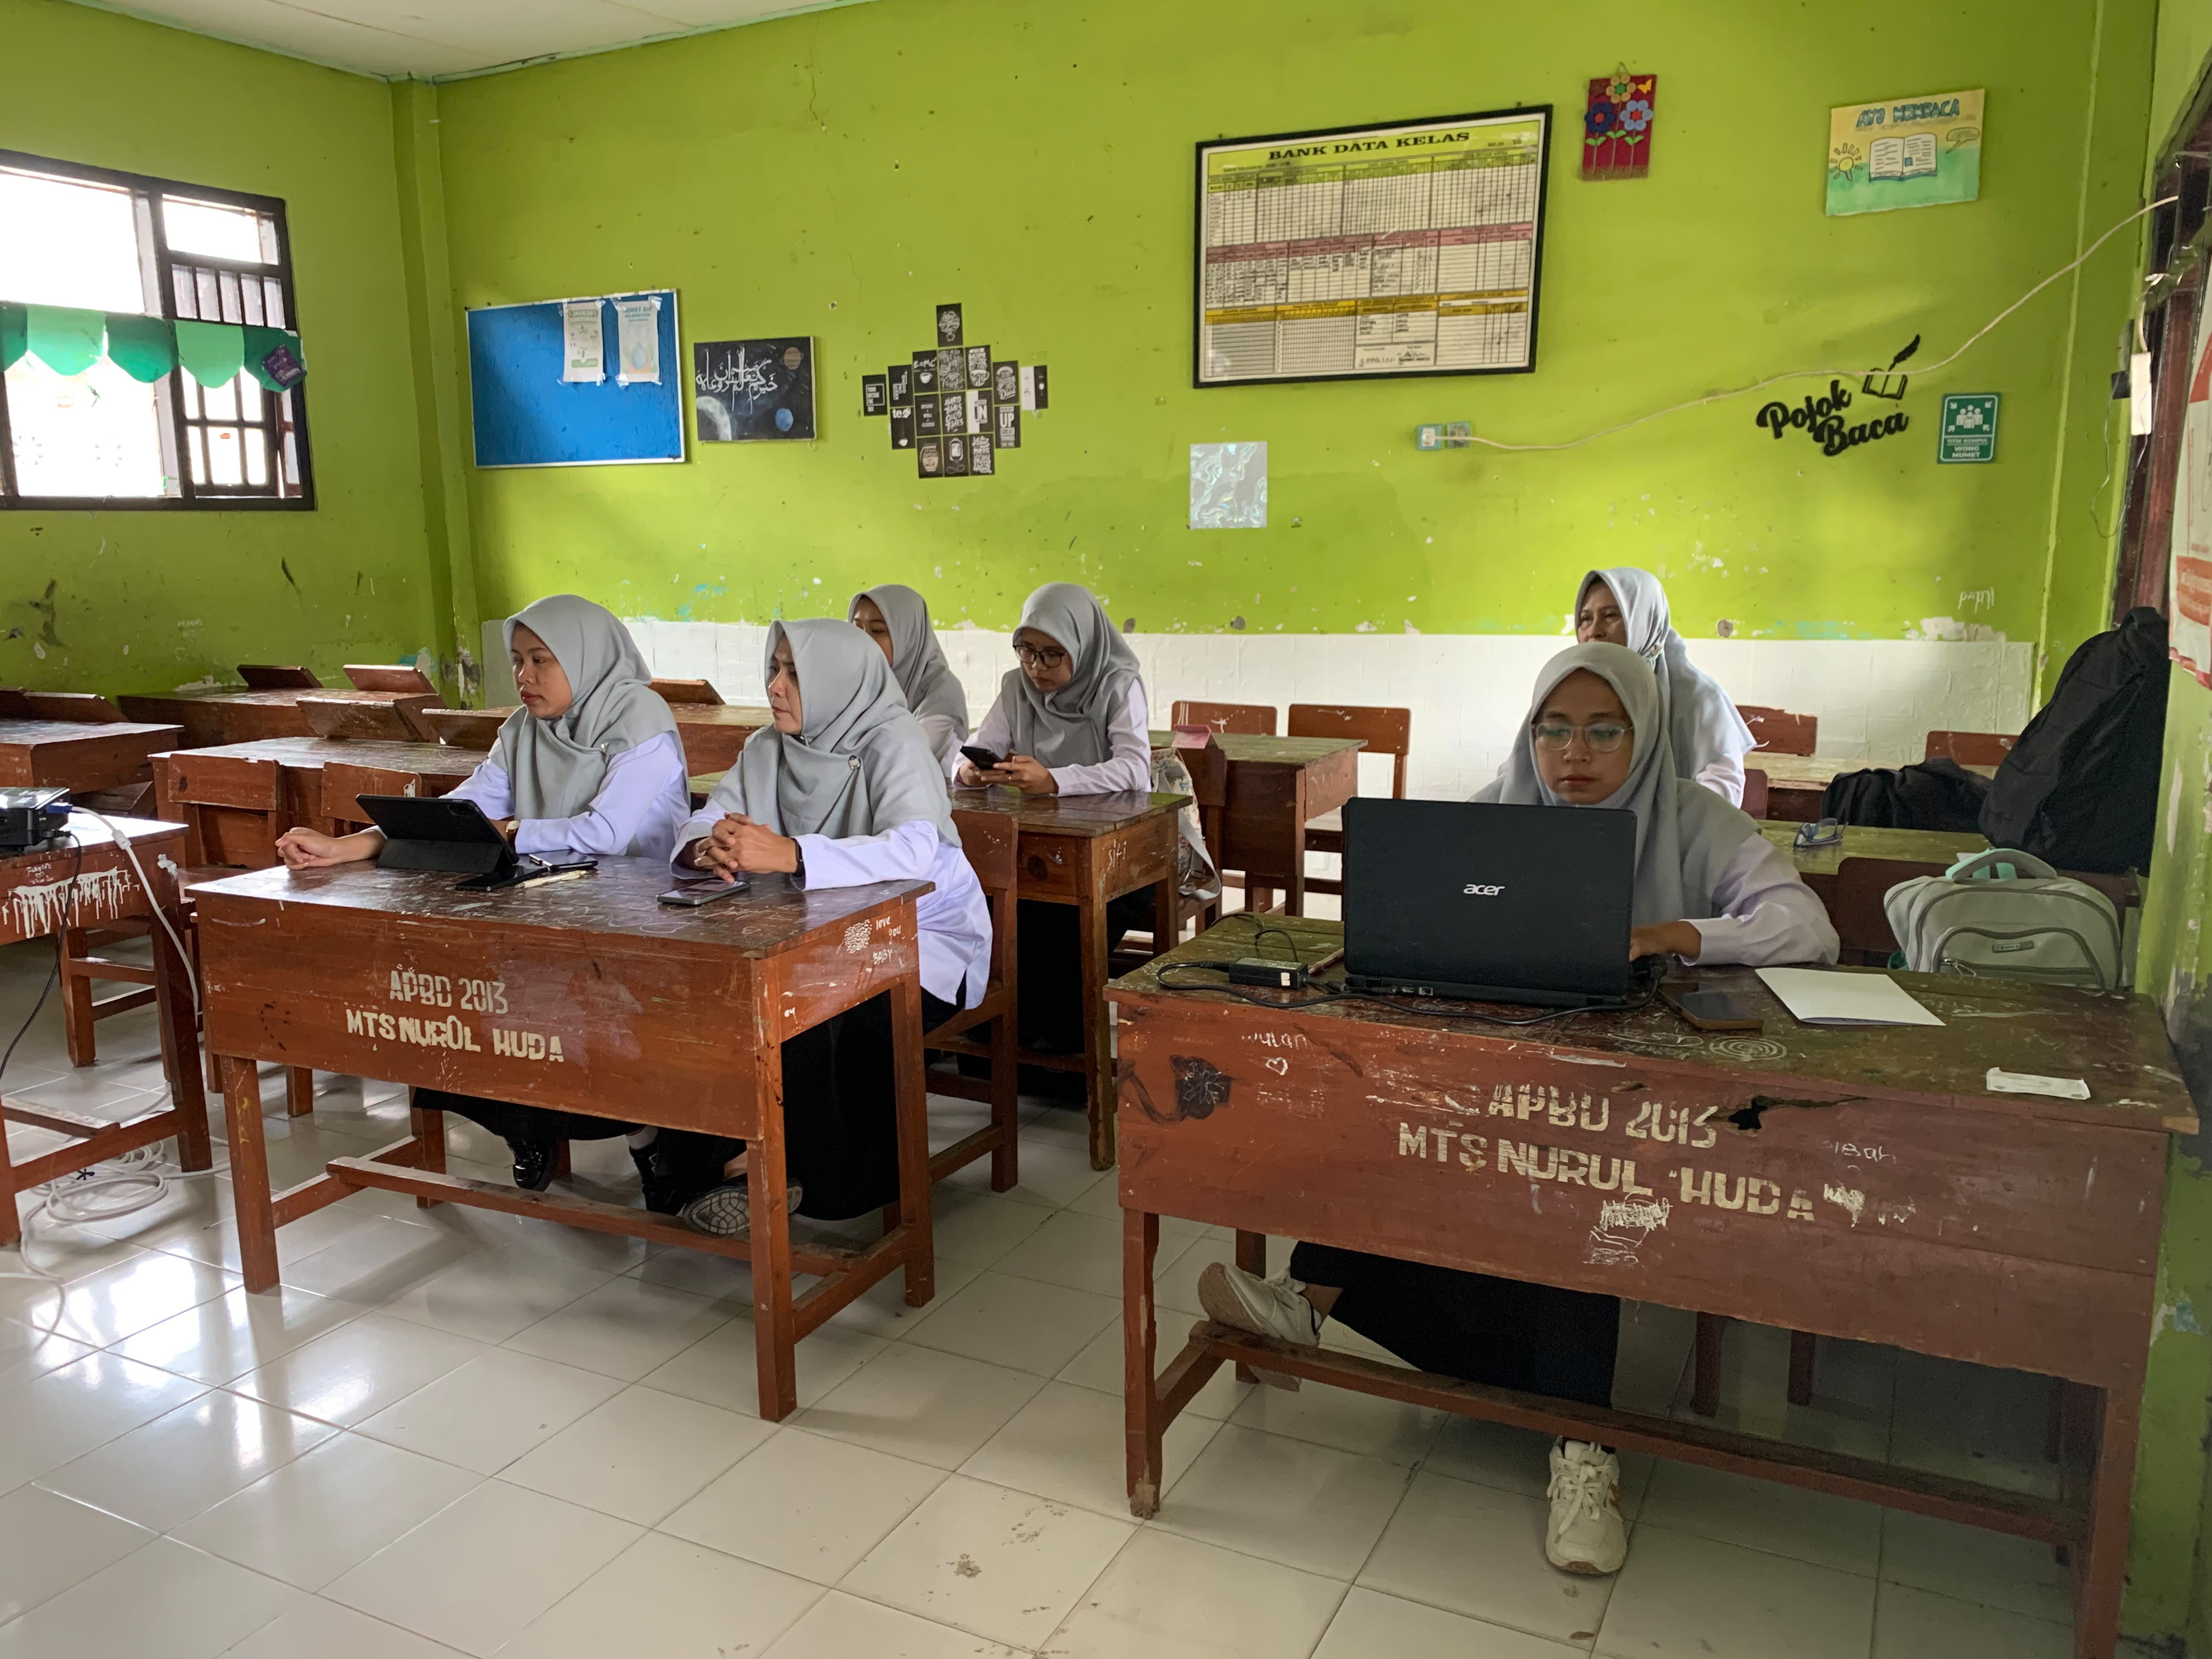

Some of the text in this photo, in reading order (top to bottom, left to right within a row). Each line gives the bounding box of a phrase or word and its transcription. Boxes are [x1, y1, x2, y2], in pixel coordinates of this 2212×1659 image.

[1855, 108, 1886, 128] AYO
[1269, 132, 1470, 160] BANK DATA KELAS
[1000, 413, 1014, 428] UP
[1756, 380, 1852, 439] Pojok
[1813, 413, 1909, 456] Baca
[1463, 884, 1505, 896] acer
[390, 970, 509, 1014] APBD 2013
[346, 1009, 396, 1040] MTS
[493, 1028, 565, 1063] HUDA
[1398, 1122, 1487, 1168] MTS
[1498, 1139, 1654, 1197] NURUL
